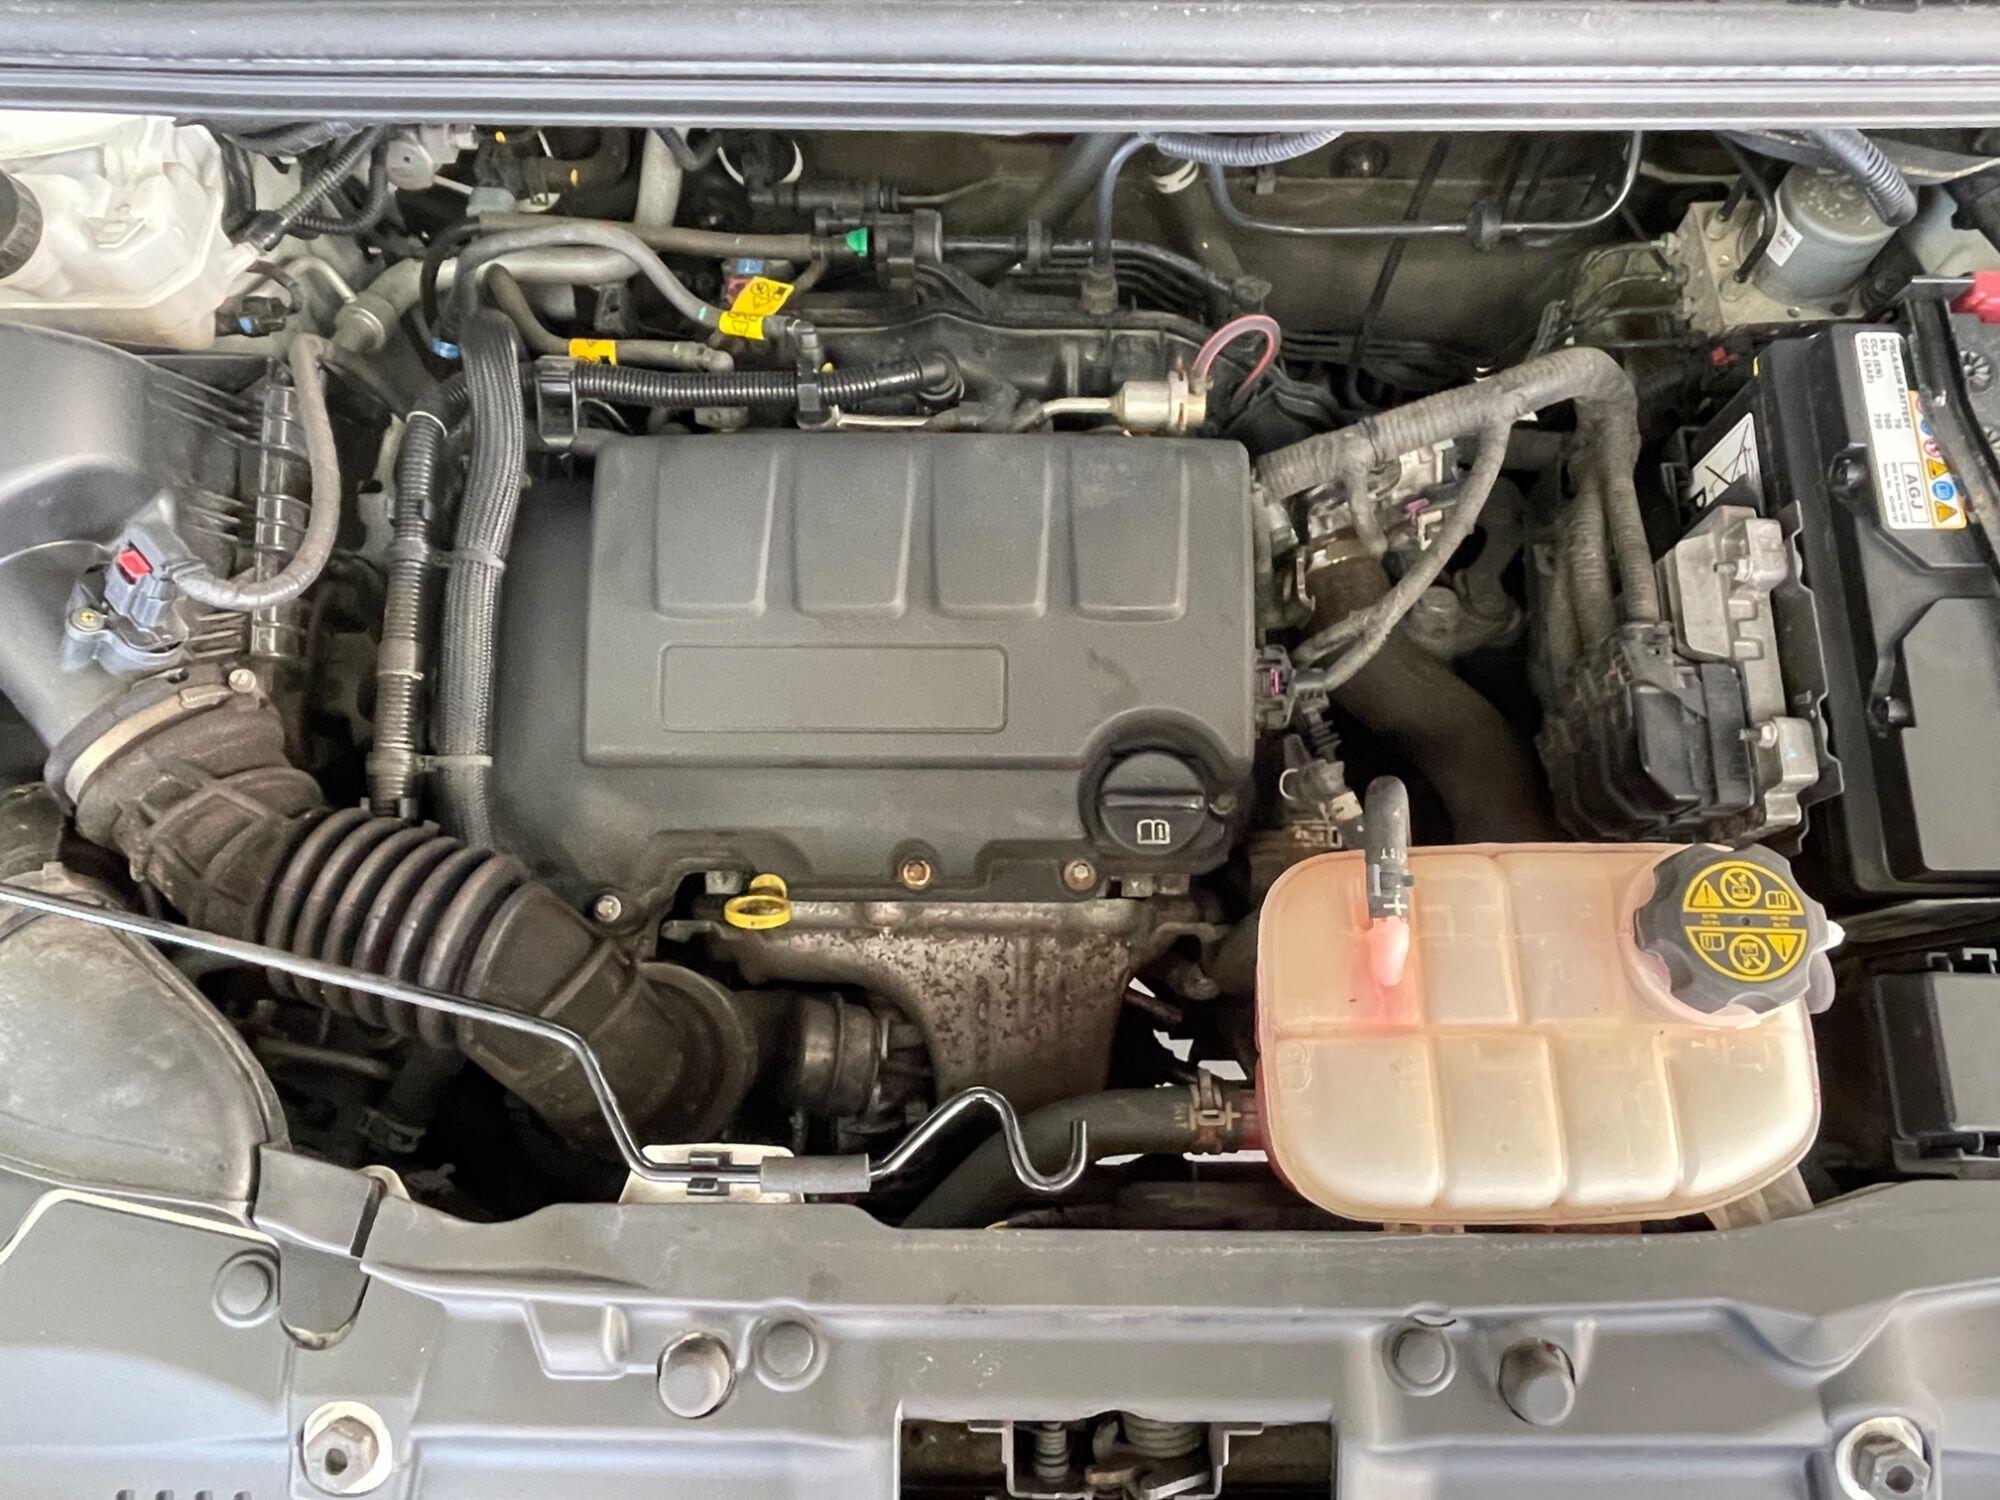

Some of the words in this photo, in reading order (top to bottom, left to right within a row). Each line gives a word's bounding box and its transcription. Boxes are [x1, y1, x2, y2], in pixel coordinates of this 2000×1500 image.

[1860, 338, 1870, 357] CCA
[1870, 338, 1880, 357] CCA
[1898, 387, 1911, 429] BATTERY
[1905, 474, 1924, 509] AGJ
